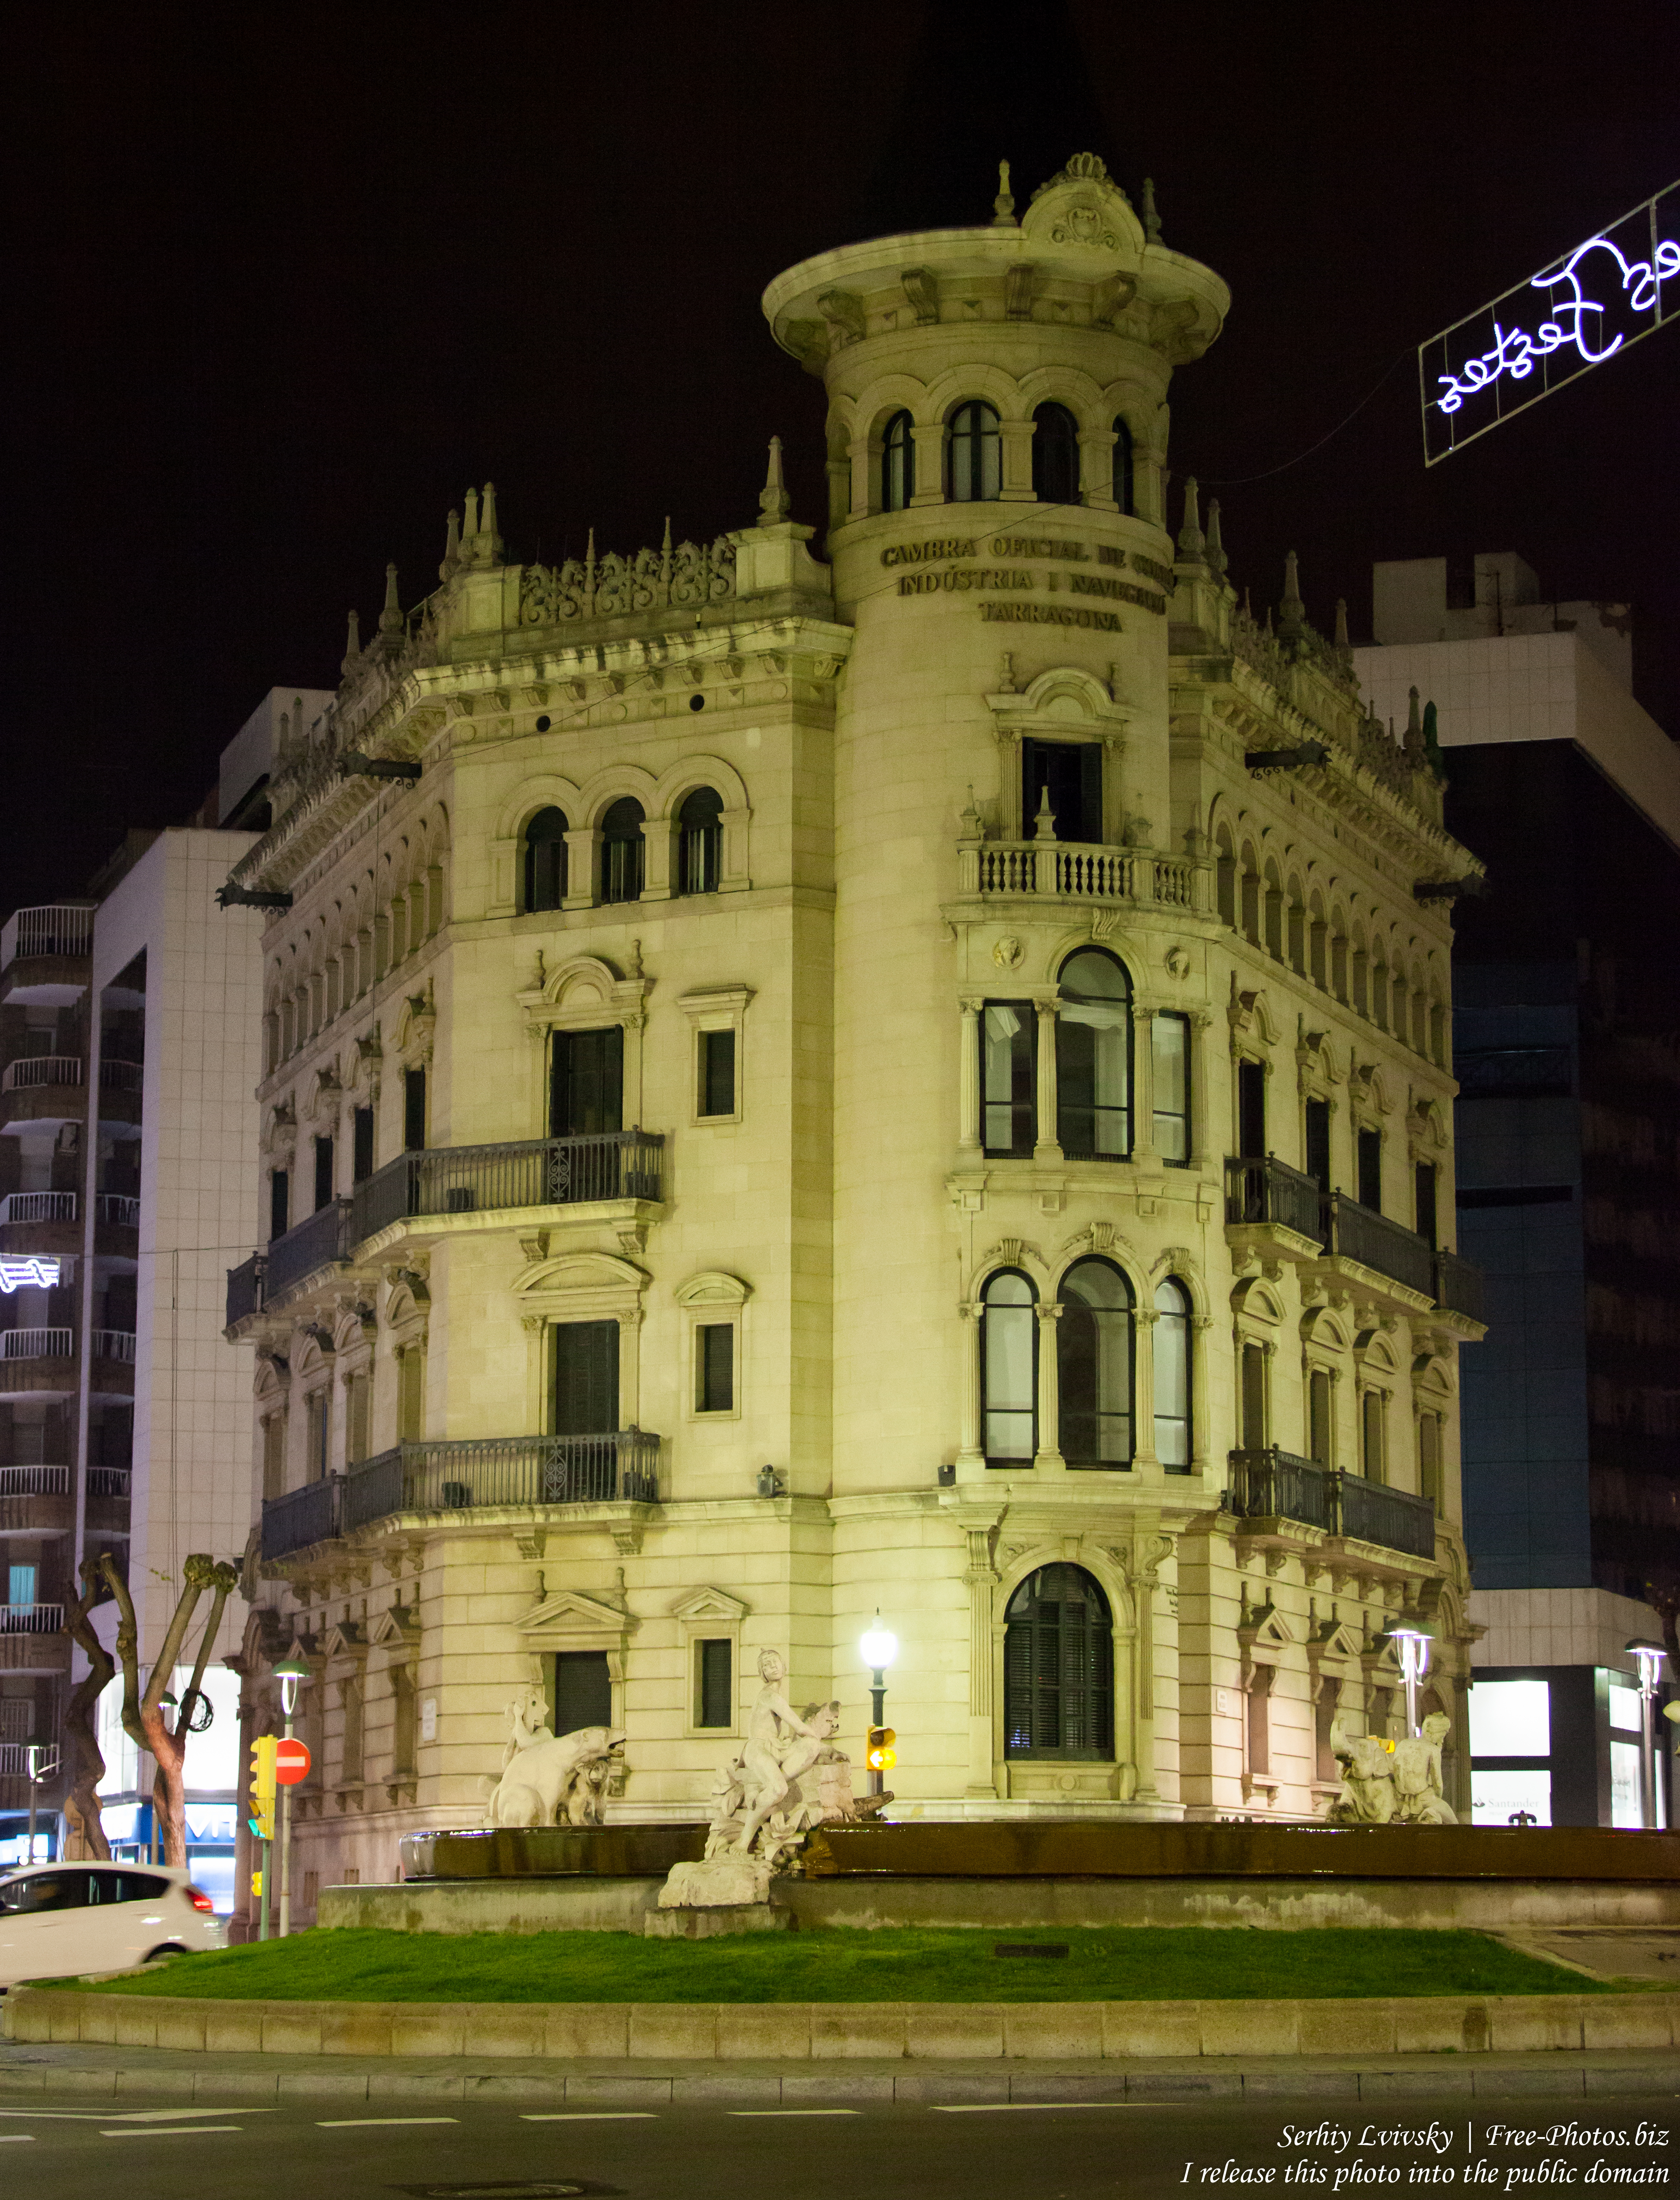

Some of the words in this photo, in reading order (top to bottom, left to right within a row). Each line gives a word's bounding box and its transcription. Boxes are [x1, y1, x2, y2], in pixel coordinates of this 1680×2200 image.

[881, 538, 977, 567] CAMBRA
[989, 538, 1089, 562] OFICIAL
[978, 603, 1124, 633] TARRAGONA
[1488, 1797, 1540, 1808] Santander
